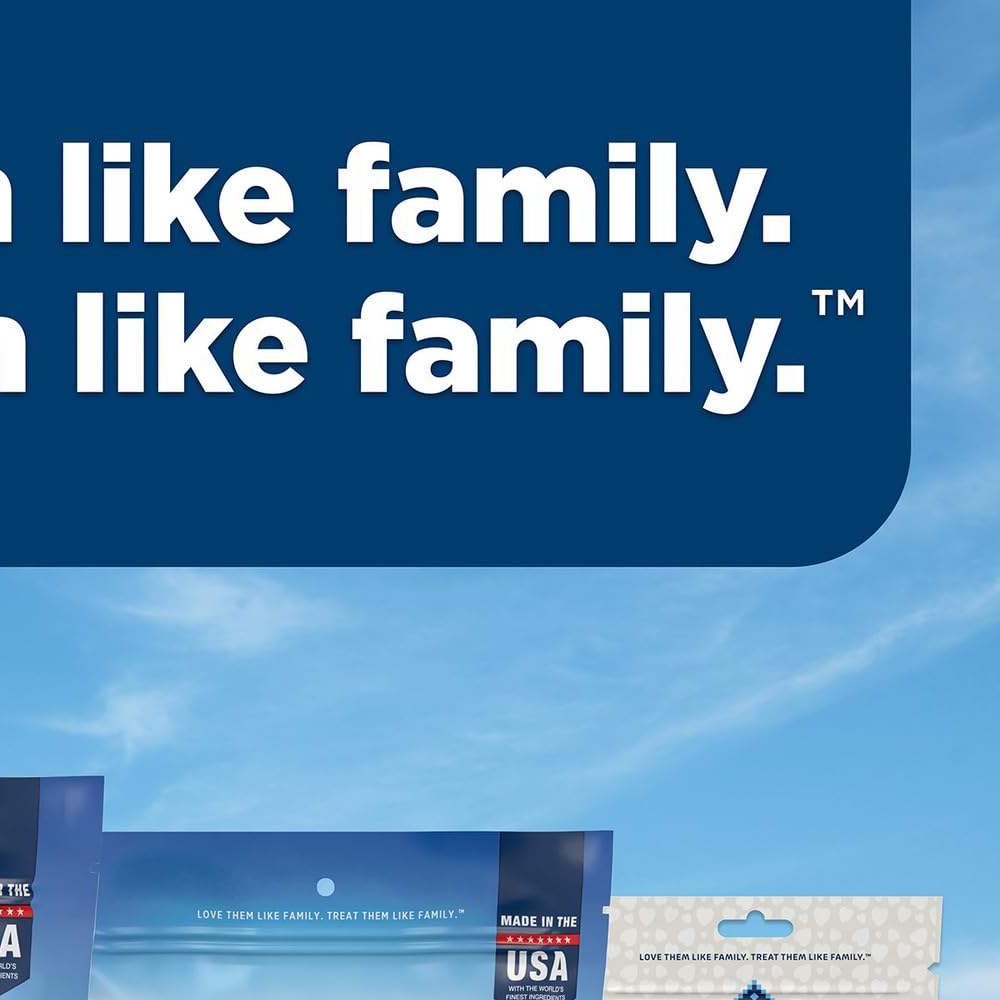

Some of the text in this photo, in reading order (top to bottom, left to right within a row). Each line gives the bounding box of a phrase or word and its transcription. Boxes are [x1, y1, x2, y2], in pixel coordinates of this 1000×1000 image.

[8, 884, 30, 896] THE
[501, 915, 577, 927] MADE IN THE
[507, 951, 568, 981] USA
